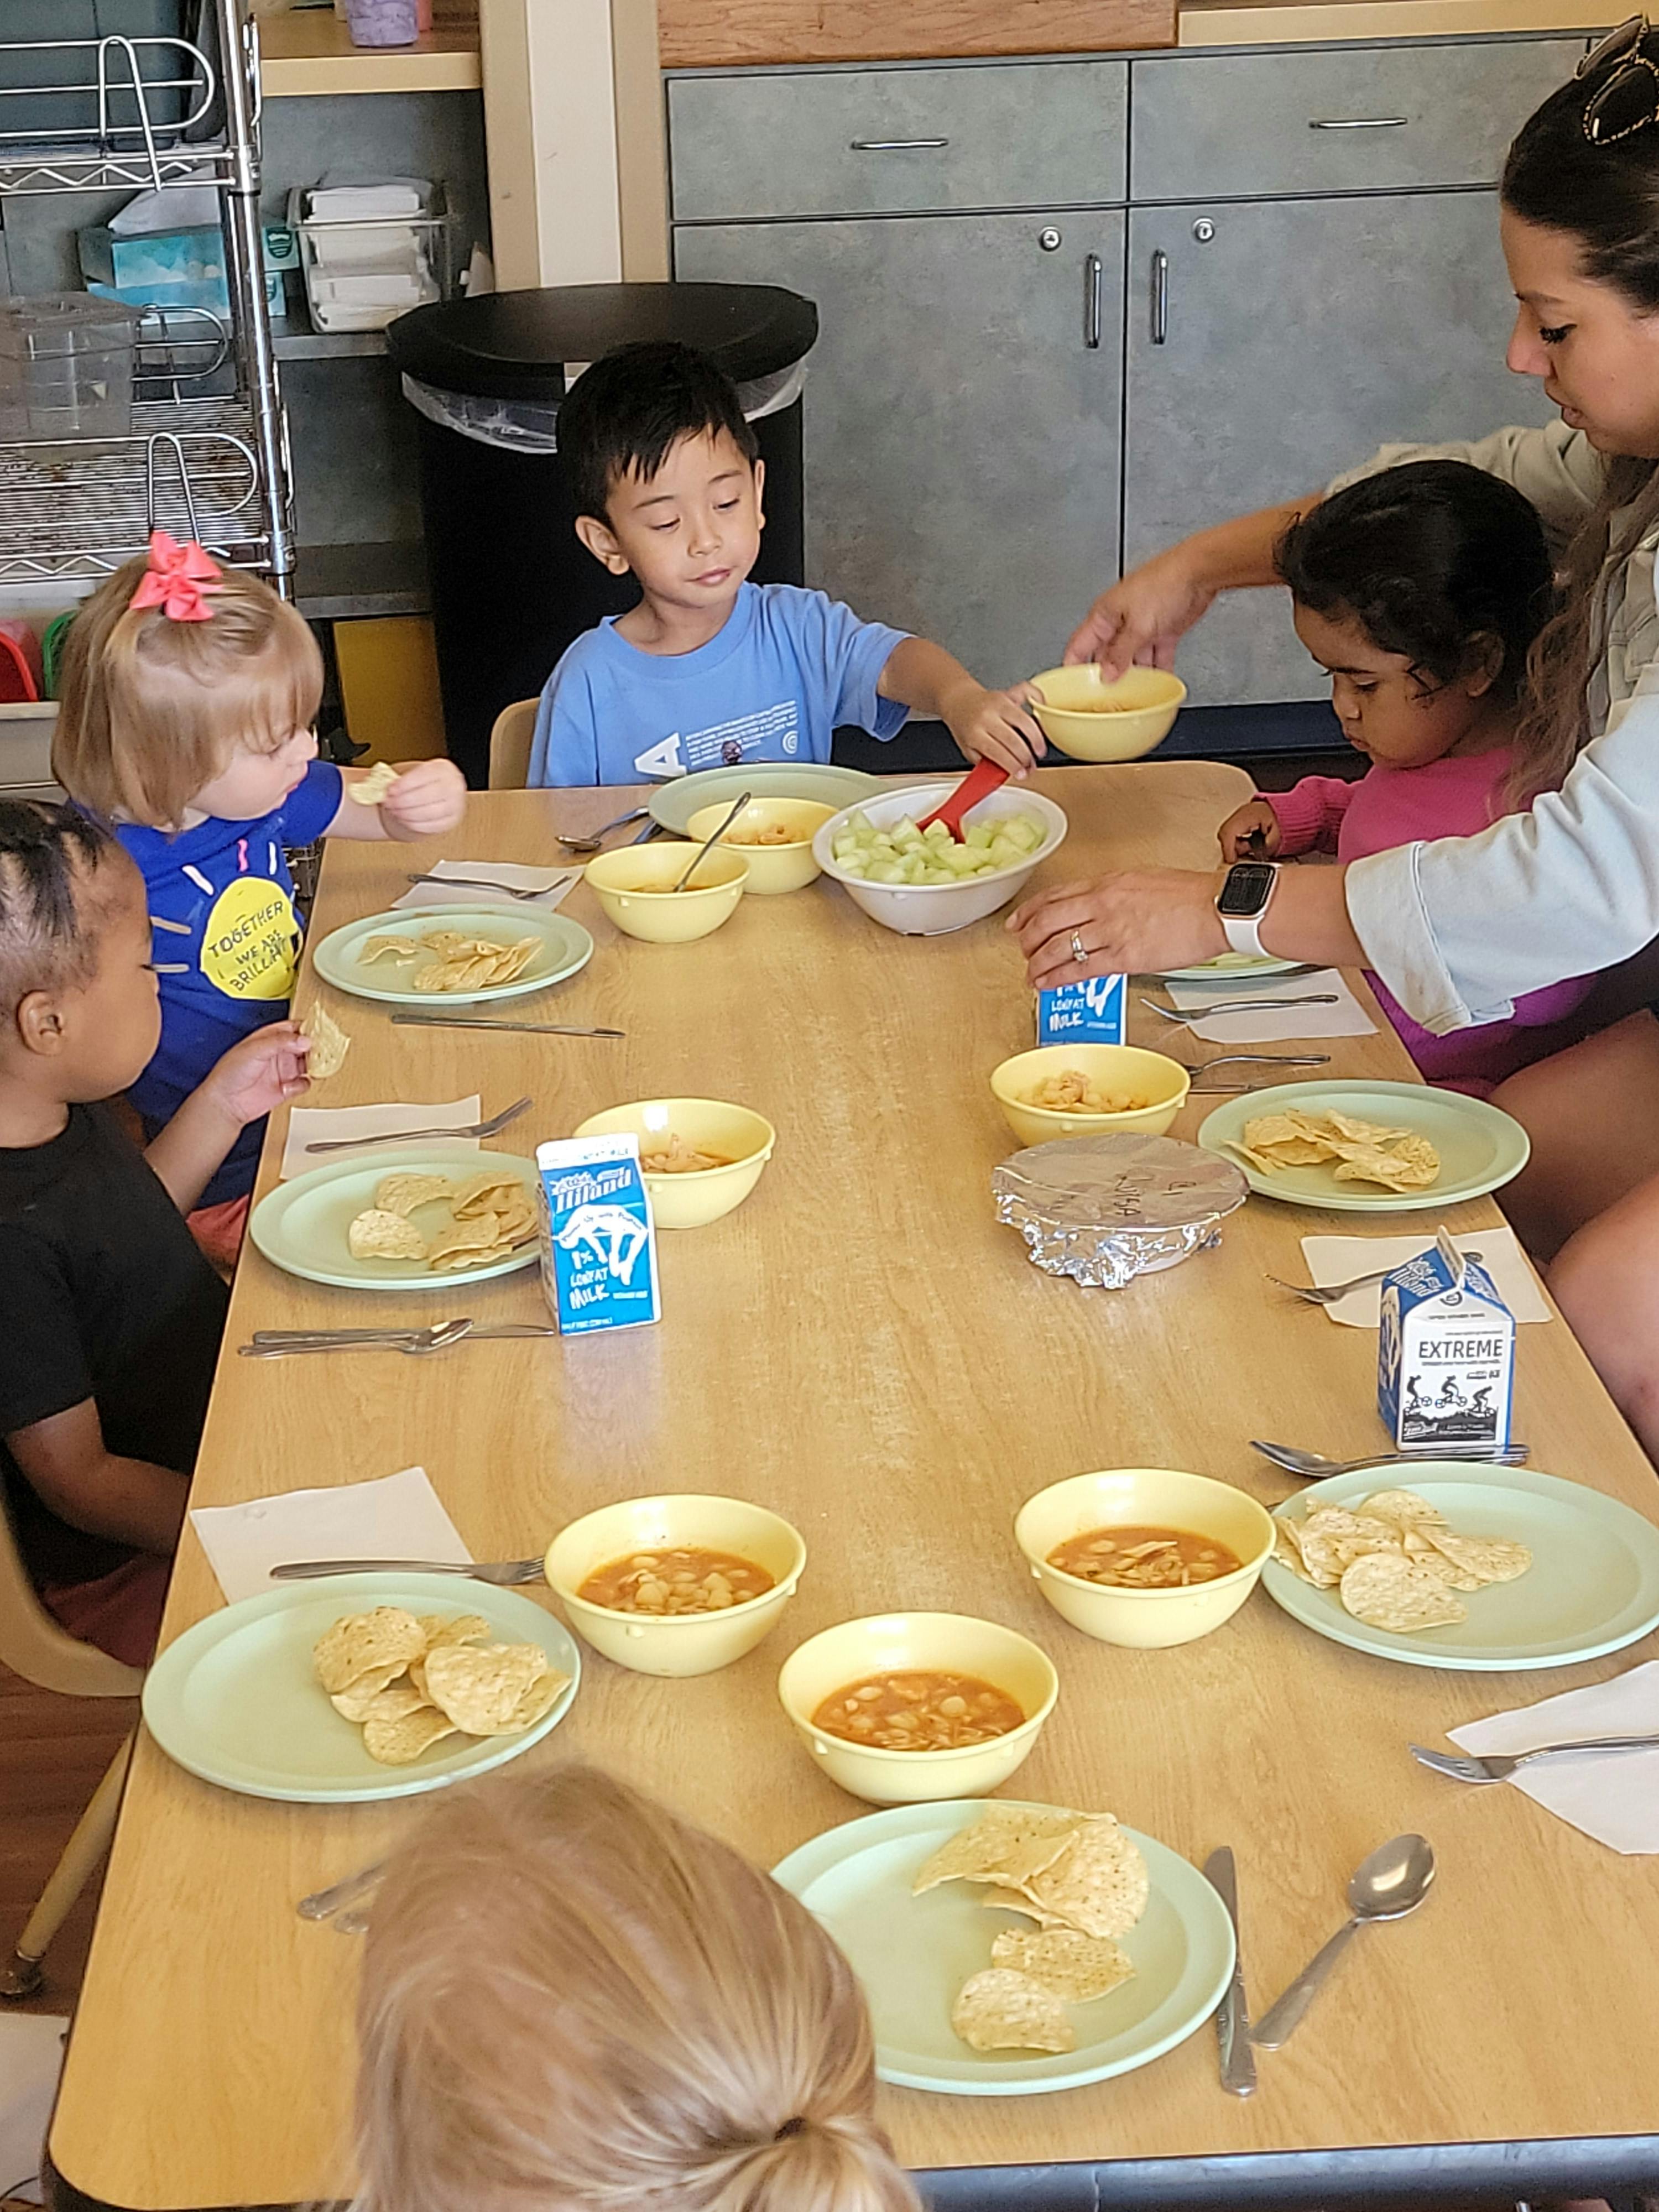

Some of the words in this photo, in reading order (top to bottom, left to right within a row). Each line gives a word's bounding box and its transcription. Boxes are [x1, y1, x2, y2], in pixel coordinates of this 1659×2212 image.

[208, 900, 284, 958] TOGETHER
[235, 945, 258, 964] WE
[1049, 1011, 1084, 1032] MILK
[571, 1250, 594, 1270] 1%
[570, 1283, 610, 1310] MILK
[1418, 1339, 1504, 1359] EXTREME
